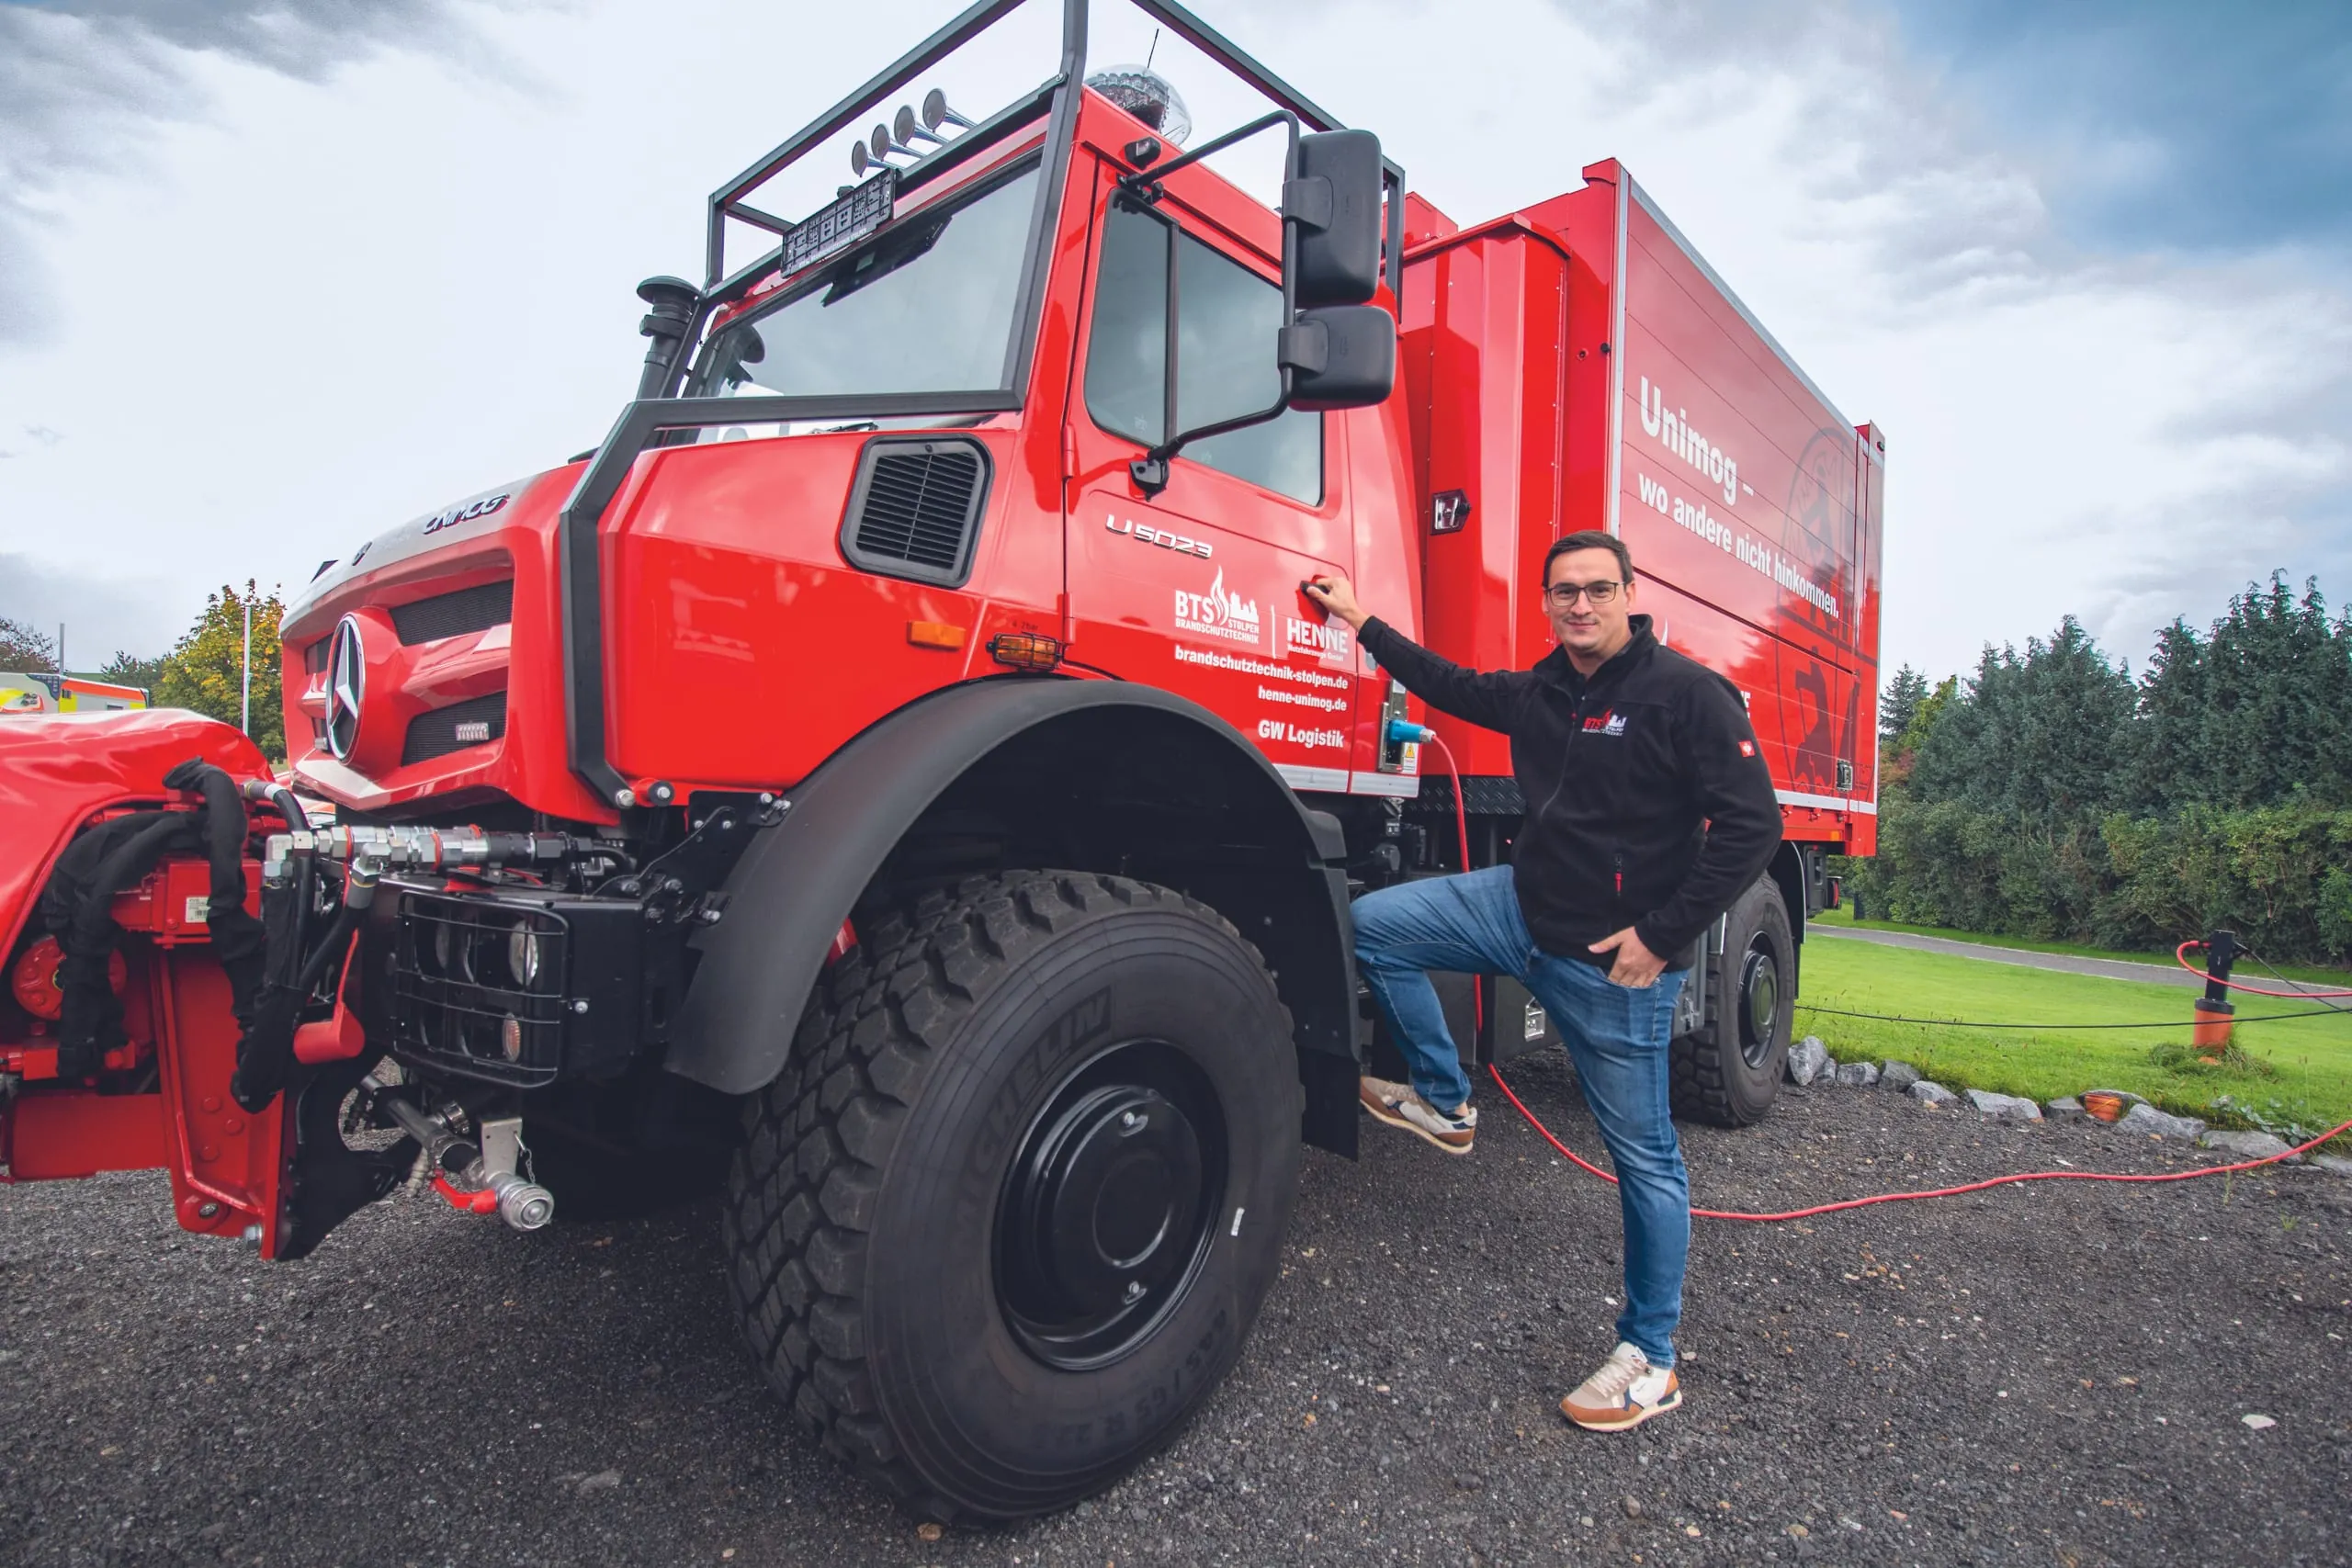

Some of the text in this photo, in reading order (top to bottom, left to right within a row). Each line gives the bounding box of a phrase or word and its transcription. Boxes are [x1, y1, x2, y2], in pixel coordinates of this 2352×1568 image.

[1640, 376, 1736, 506] Unimog
[1105, 513, 1213, 559] U 5023
[1638, 472, 1668, 514] wo
[1673, 496, 1733, 553] andere
[1736, 533, 1771, 576] nicht
[1774, 552, 1839, 618] hinkommen.
[1175, 590, 1215, 625] BTS
[1175, 618, 1260, 644] BRANDSCHUTZTECHNIK
[1228, 618, 1260, 634] STOLPEN
[1287, 617, 1348, 654] HENNE
[1175, 645, 1348, 689] brandschutztechnik-stolpen.de
[1258, 685, 1347, 712] henne-unimog.de
[1258, 719, 1344, 748] GW Logistik
